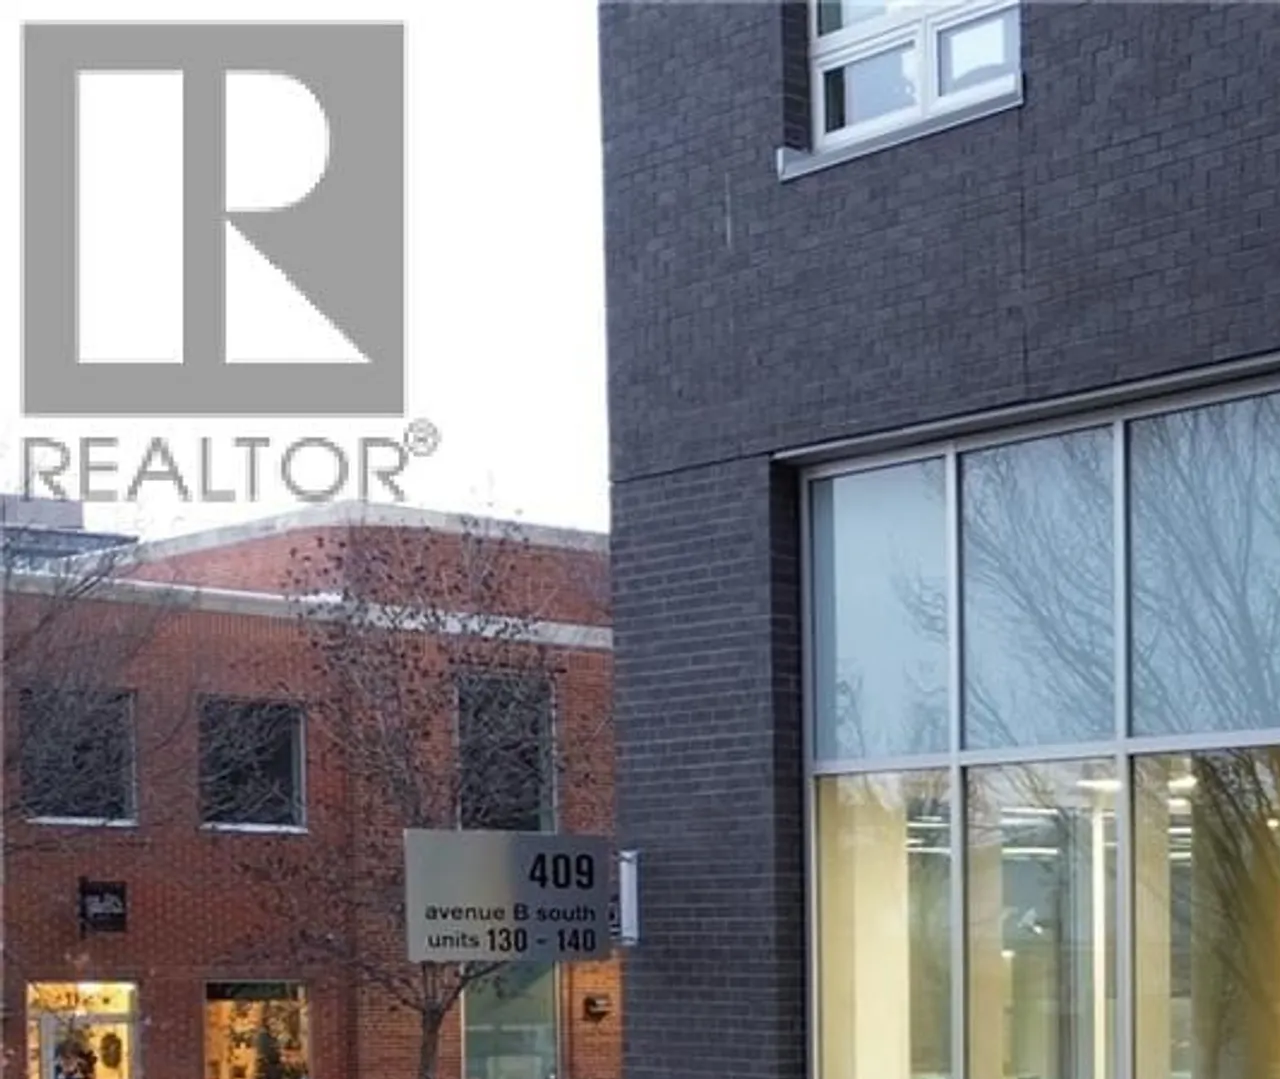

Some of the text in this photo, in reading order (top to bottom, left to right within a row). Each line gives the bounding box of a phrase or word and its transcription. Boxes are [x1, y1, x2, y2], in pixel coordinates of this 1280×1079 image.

[529, 853, 595, 890] 409
[424, 903, 596, 922] avenue B south
[427, 930, 480, 949] units
[487, 928, 528, 952] 130
[556, 928, 596, 952] 140
